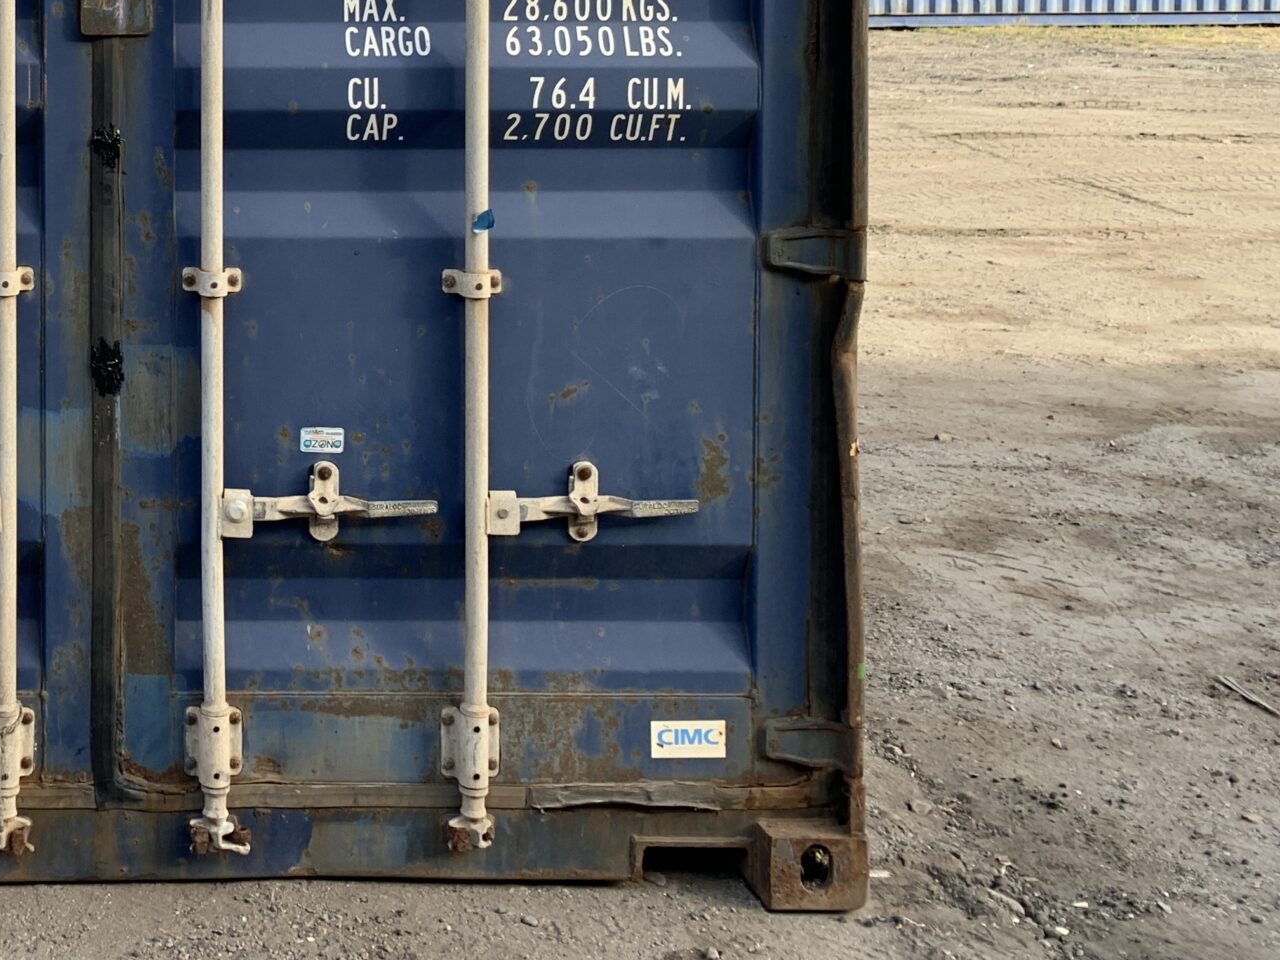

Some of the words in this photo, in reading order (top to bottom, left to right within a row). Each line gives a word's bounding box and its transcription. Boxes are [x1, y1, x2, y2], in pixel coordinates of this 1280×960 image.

[345, 26, 431, 57] CARGO
[506, 26, 614, 56] 63,050
[623, 26, 682, 57] LBS.
[348, 77, 386, 109] CU.
[530, 77, 595, 109] 76.4
[628, 77, 692, 109] CU.M.
[346, 114, 404, 140] CAP.
[504, 113, 592, 141] 2,700
[610, 113, 686, 141] CU.FT.
[657, 729, 720, 745] CIMC
